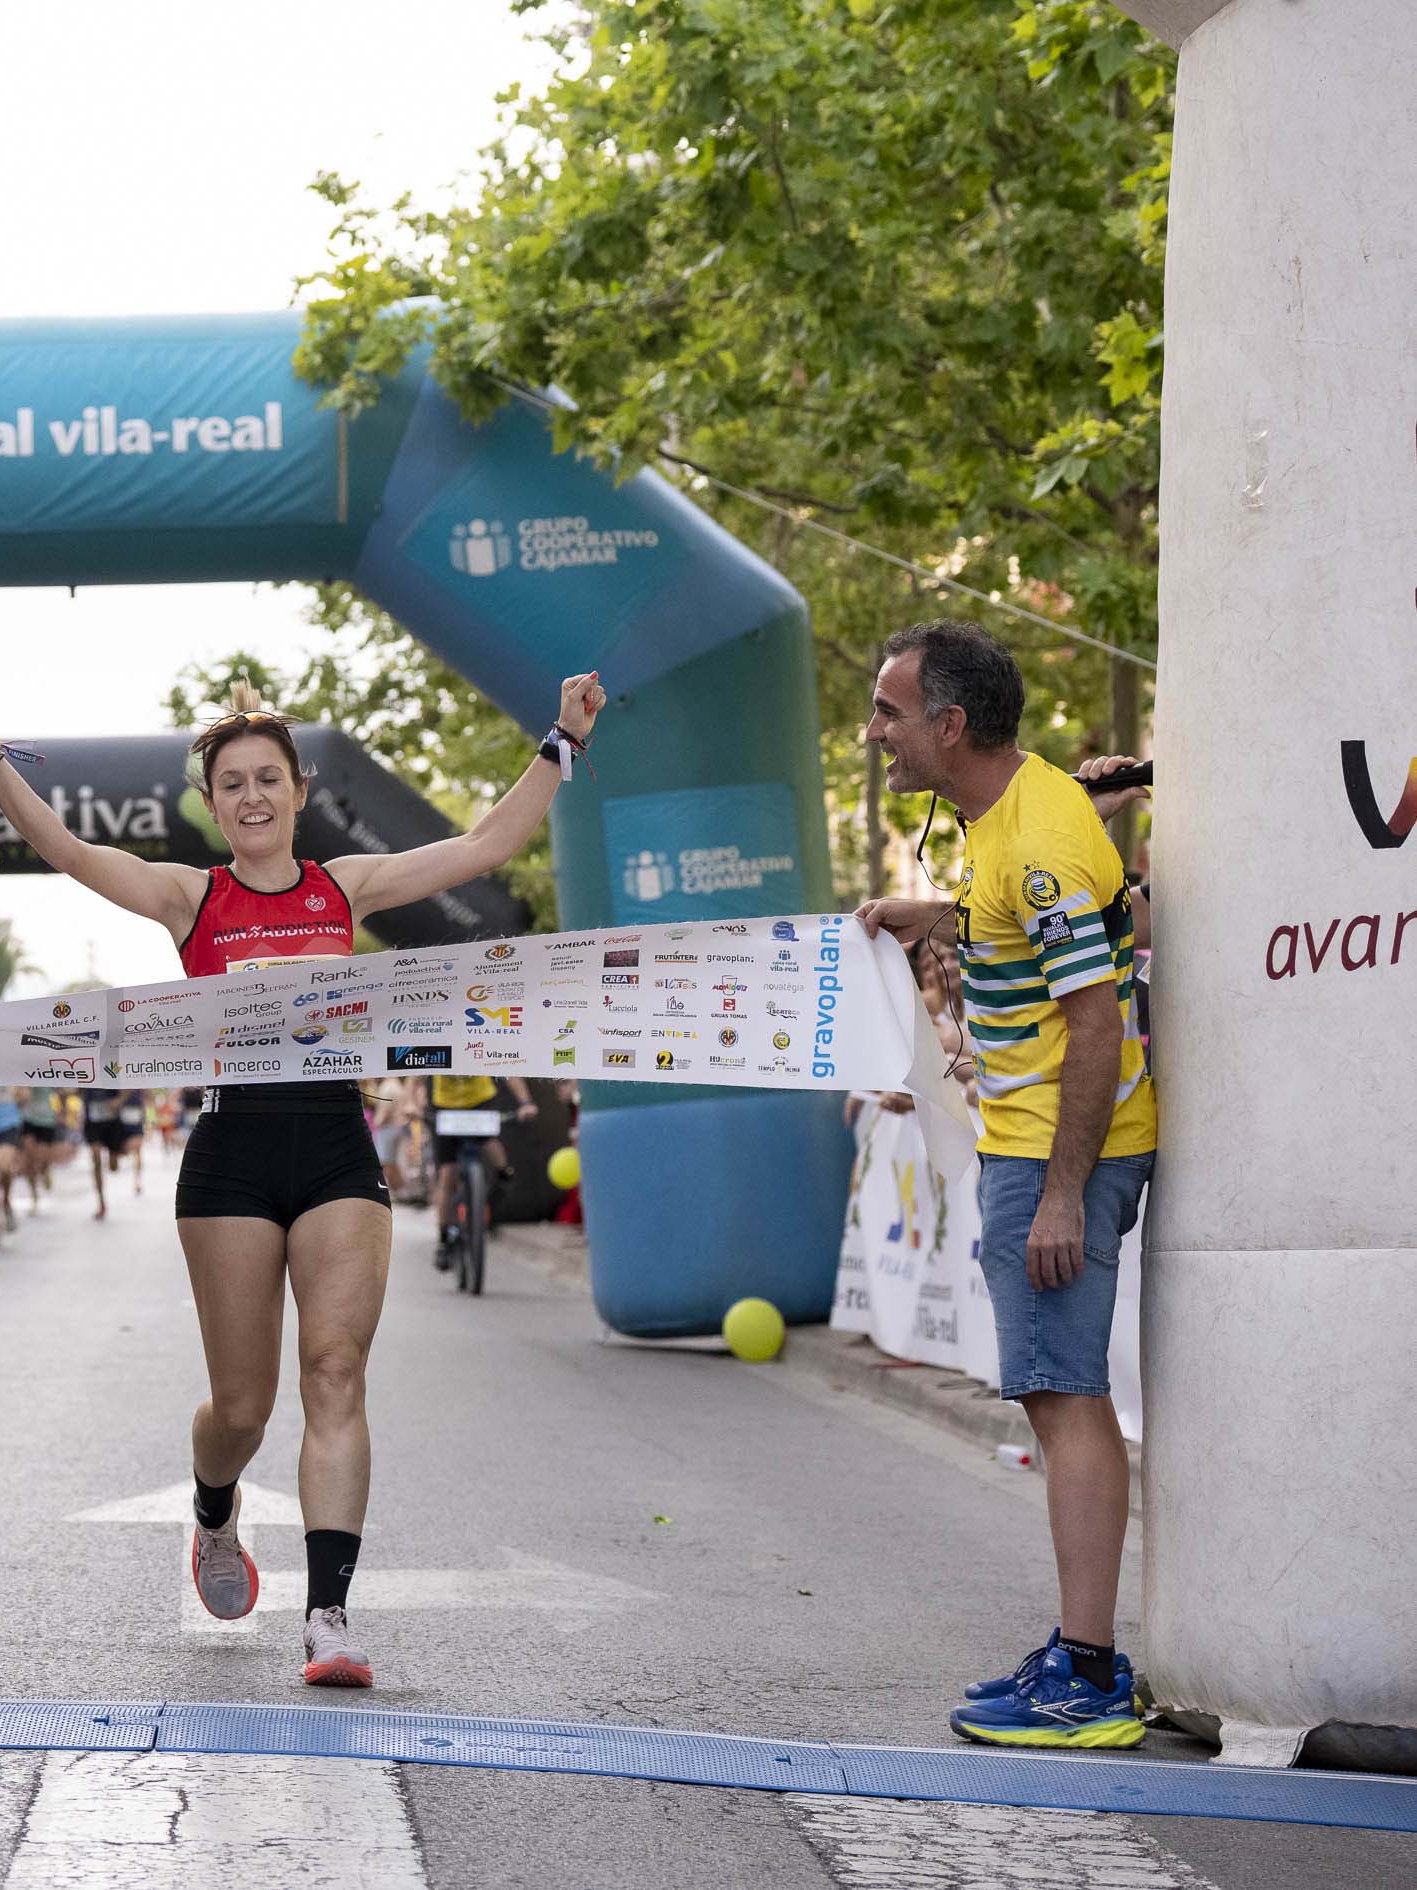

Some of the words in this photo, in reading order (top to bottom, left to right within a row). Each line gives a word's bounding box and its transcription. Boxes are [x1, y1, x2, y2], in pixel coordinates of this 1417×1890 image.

[48, 402, 282, 456] vila-real
[519, 516, 588, 537] GRUPO
[519, 530, 659, 551] COOPERATIVO
[520, 548, 618, 571] CAJAMAR
[679, 846, 739, 865] GRUPO
[214, 927, 247, 945] RUN
[262, 920, 348, 938] ADDICTION
[1043, 931, 1071, 944] FOREVER
[553, 940, 596, 950] AMBAR
[393, 958, 418, 968] A&A
[473, 960, 523, 971] Ajuntament
[395, 965, 441, 977] podoactiva
[603, 975, 628, 983] CREA
[148, 991, 202, 1003] COOPERATIVA
[293, 992, 319, 1007] 60
[224, 1001, 282, 1018] Isoltec
[255, 1009, 282, 1018] Group
[326, 1000, 369, 1019] SACMI
[608, 1004, 638, 1012] Lucciola
[26, 1018, 81, 1031] VILLARREAL
[125, 1014, 194, 1033] COVALCA
[409, 1026, 442, 1034] vila-real
[214, 1036, 281, 1048] FULGOR
[486, 1050, 519, 1059] Vila-real
[125, 1058, 203, 1075] ruralnostra
[223, 1059, 281, 1073] incerco
[303, 1055, 362, 1068] AZAHAR
[25, 1066, 88, 1079] vidres
[302, 1066, 363, 1076] ESPECTÁCULOS
